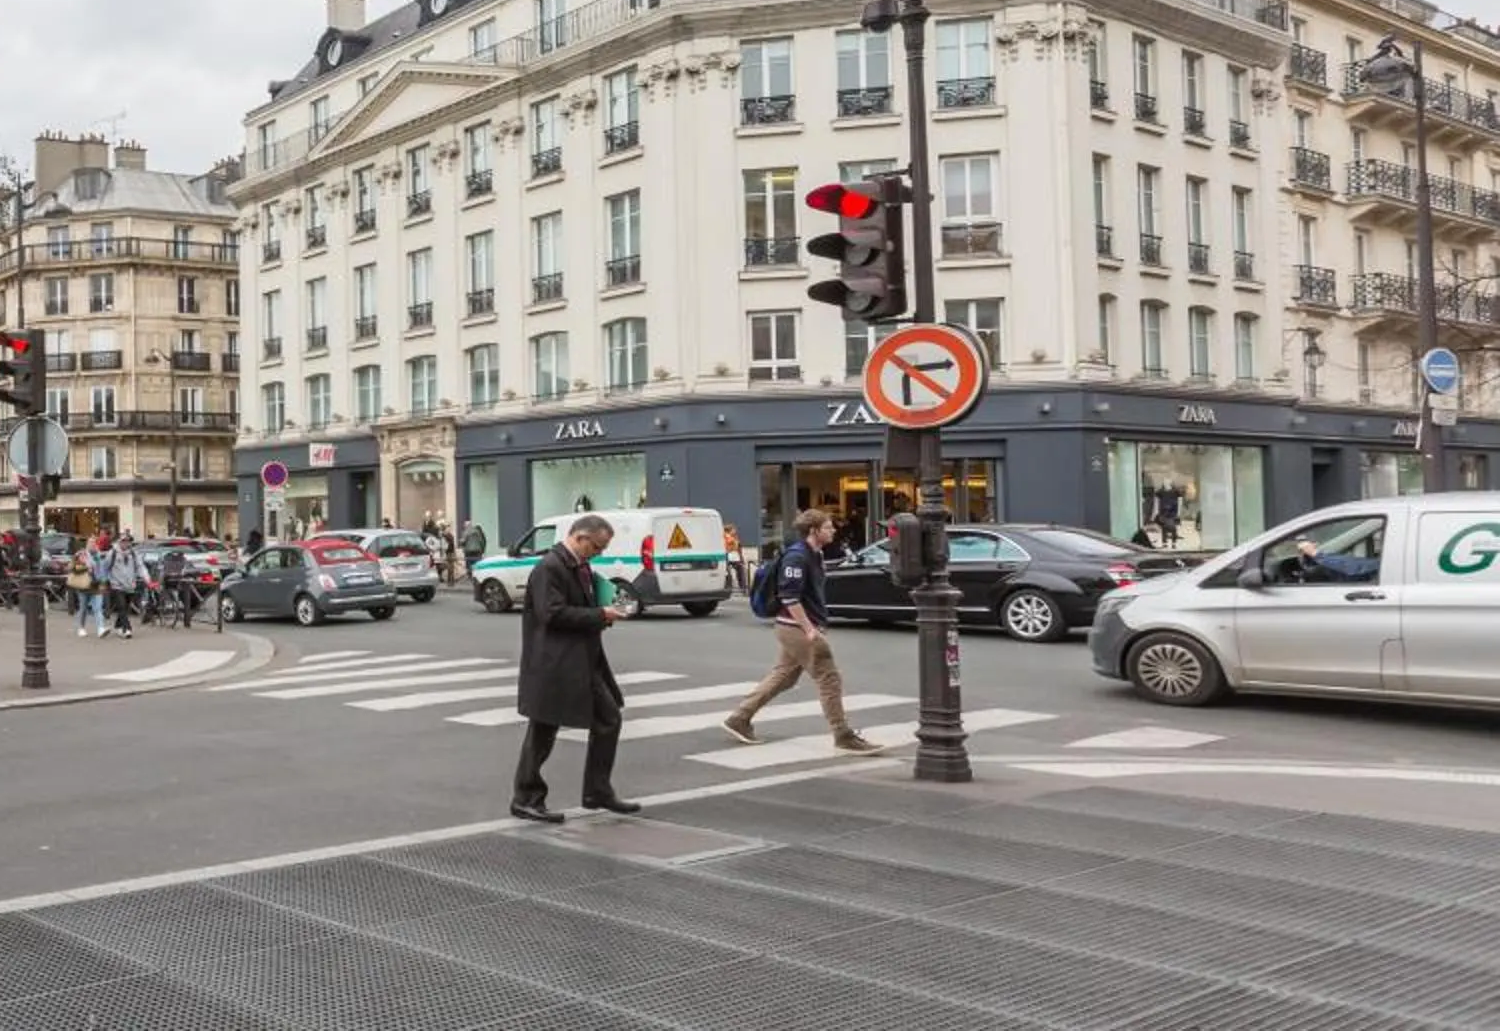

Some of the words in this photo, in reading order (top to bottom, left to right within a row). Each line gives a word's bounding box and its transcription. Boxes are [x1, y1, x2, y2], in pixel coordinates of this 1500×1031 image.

[827, 402, 888, 425] ZA
[1178, 404, 1217, 424] ZARA
[555, 419, 604, 440] ZARA
